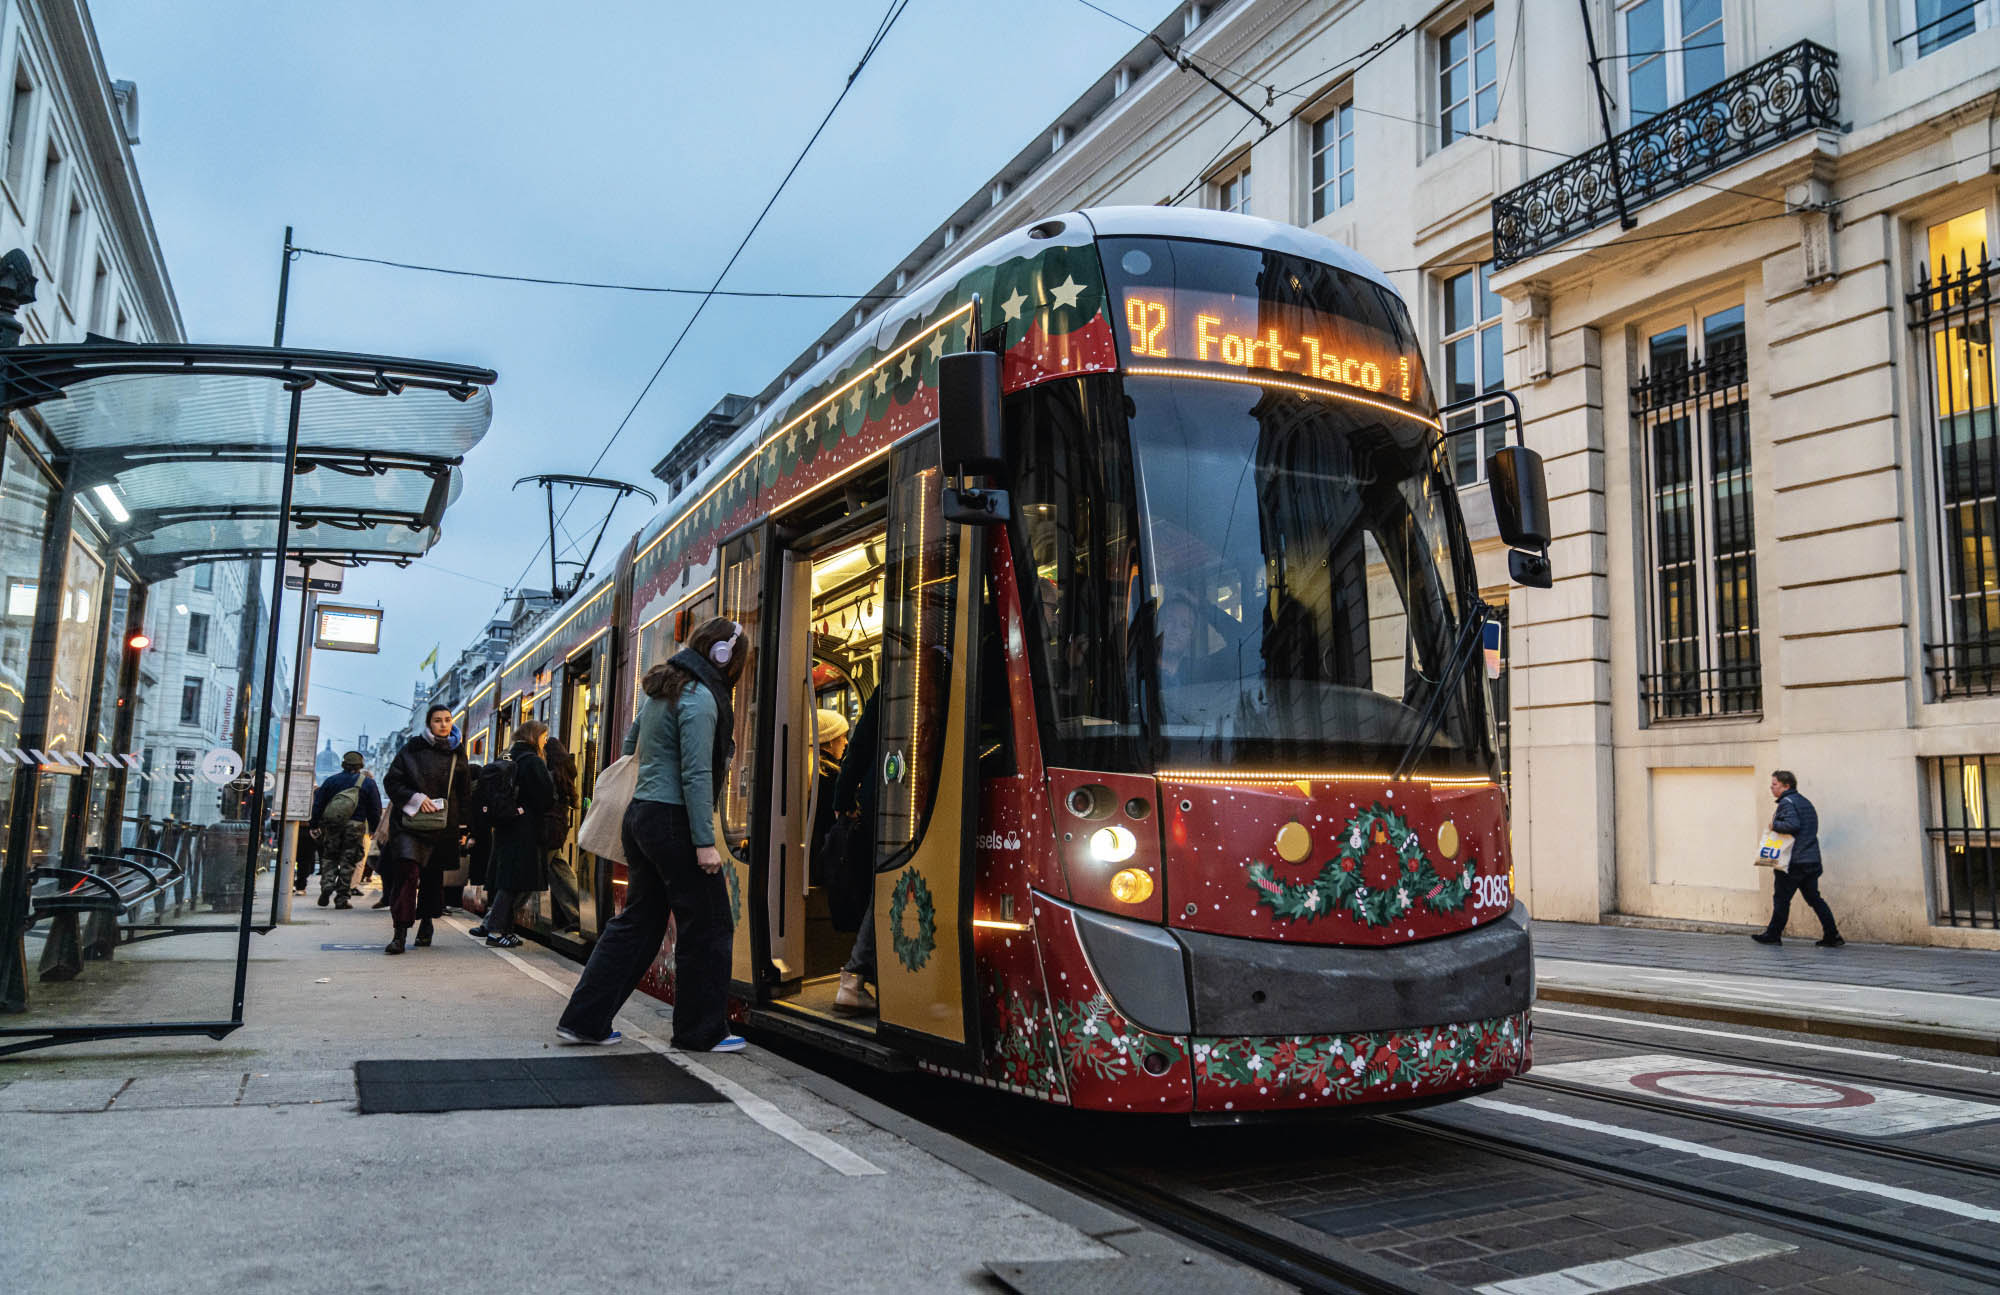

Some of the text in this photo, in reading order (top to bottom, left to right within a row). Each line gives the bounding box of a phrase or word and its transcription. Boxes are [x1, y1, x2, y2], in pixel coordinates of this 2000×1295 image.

[1127, 298, 1382, 392] 92 Fort-Jaco
[220, 686, 235, 741] Philanthropy
[1760, 847, 1781, 860] EU
[1473, 875, 1508, 910] 3085
